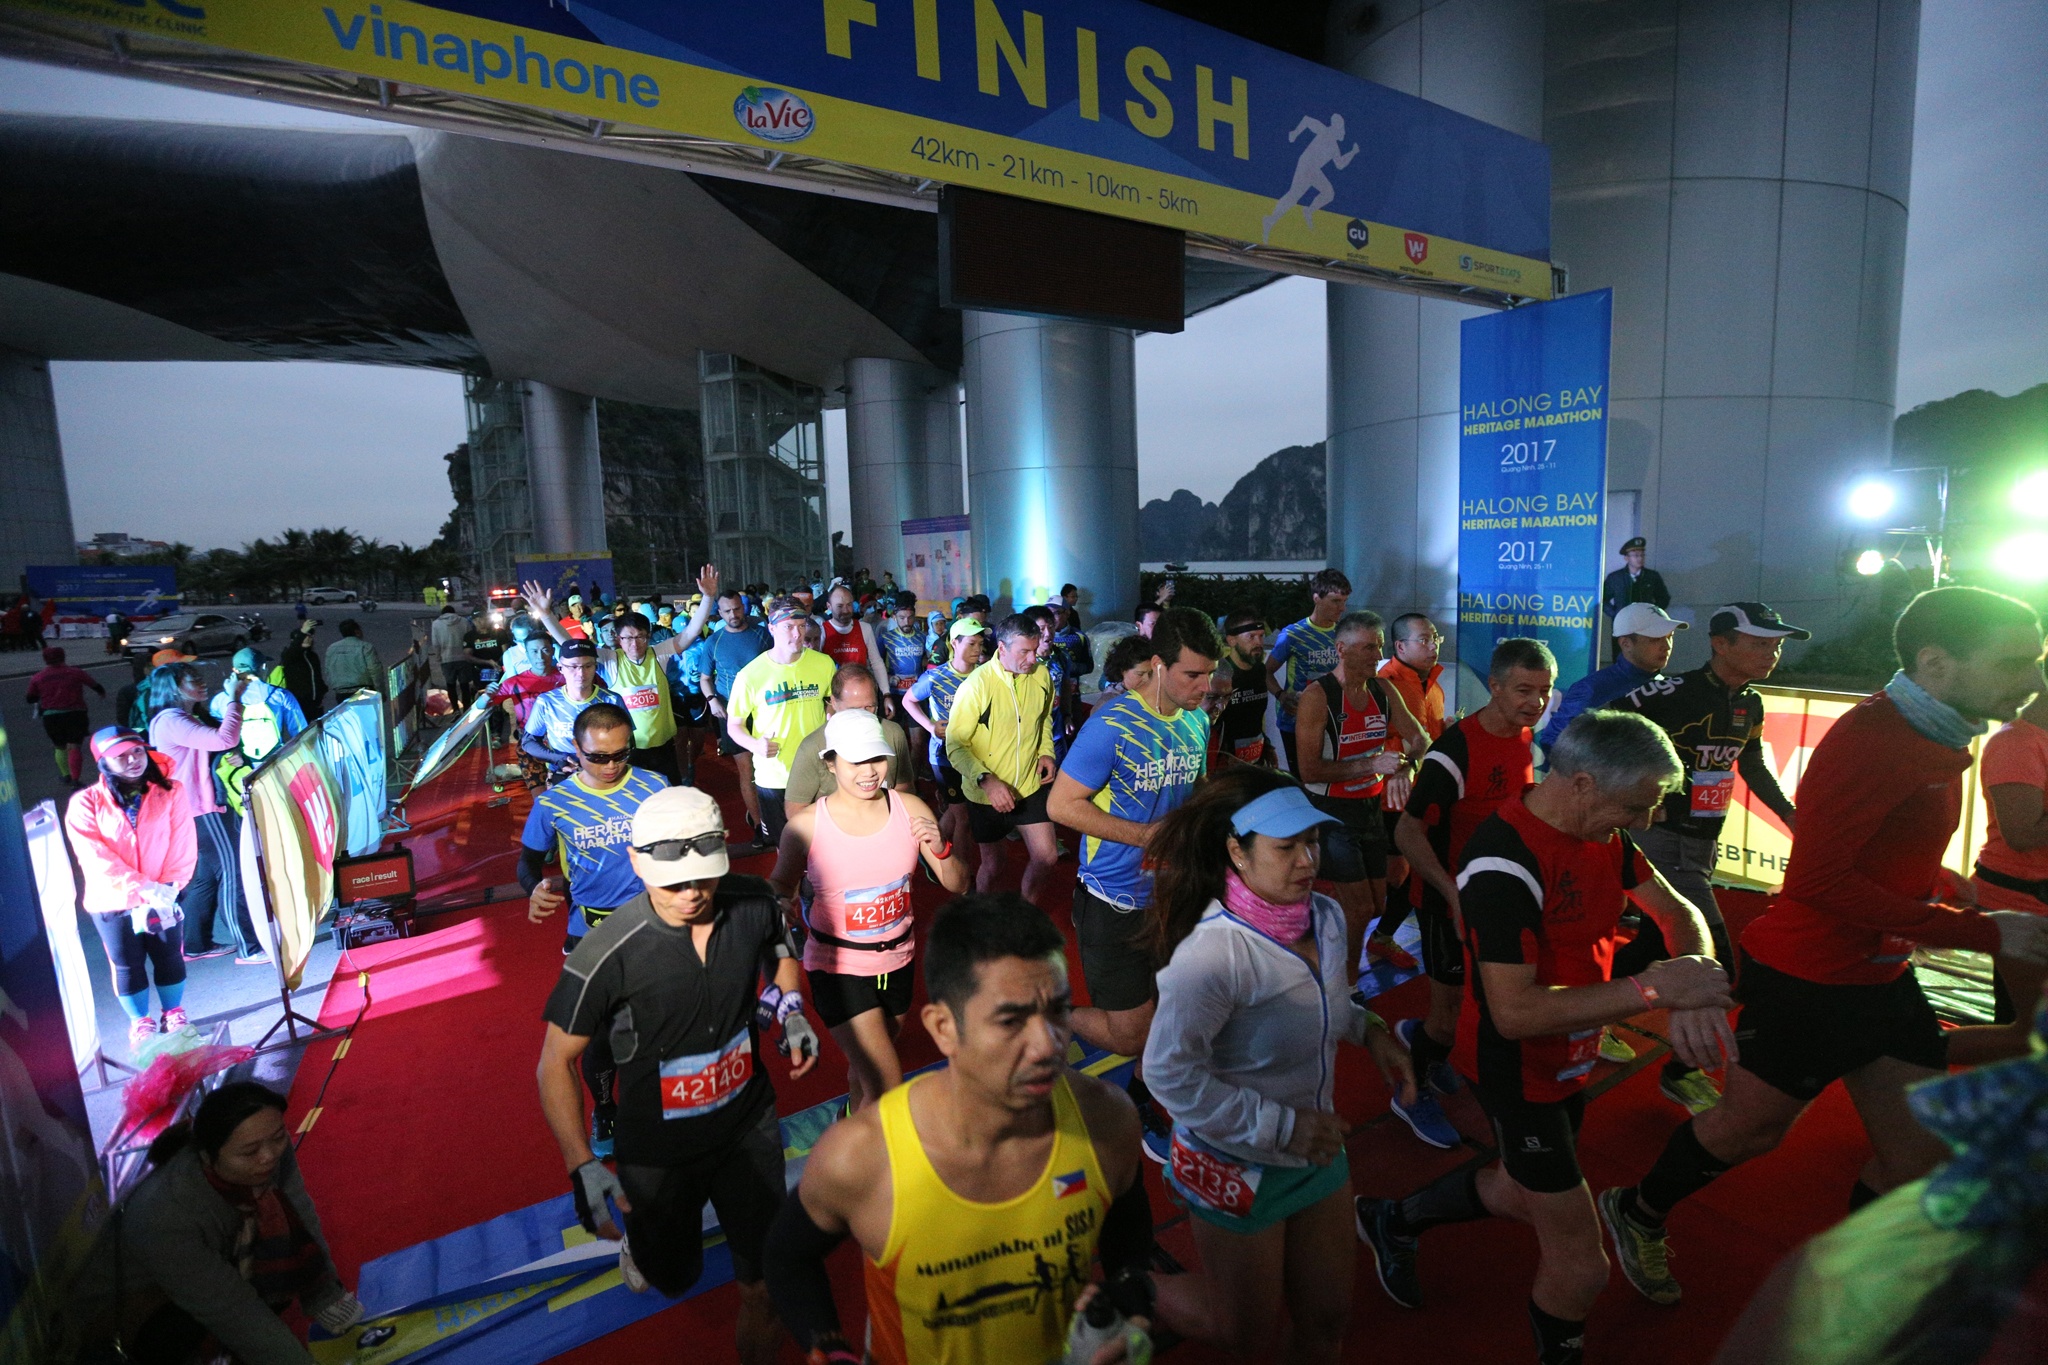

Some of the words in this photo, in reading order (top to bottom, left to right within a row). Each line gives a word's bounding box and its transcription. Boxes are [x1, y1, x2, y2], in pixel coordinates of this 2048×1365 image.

[324, 6, 660, 108] vinaphone
[823, 0, 1250, 161] FINISH
[911, 136, 979, 171] 42km
[1003, 154, 1064, 188] 21km
[1087, 172, 1140, 204] 10km
[1159, 188, 1198, 215] 5km
[1349, 228, 1366, 241] GU
[1464, 393, 1551, 421] HALONG
[1560, 385, 1602, 408] BAY
[1464, 419, 1521, 436] HERITAGE
[1524, 408, 1602, 429] MARATHON
[1501, 439, 1557, 465] 2017
[1463, 495, 1548, 515] HALONG
[1556, 492, 1598, 511] BAY
[1463, 518, 1518, 530] HERITAGE
[1522, 514, 1597, 528] MARATHON
[1498, 541, 1553, 562] 2017
[1460, 593, 1544, 611] HALONG
[1553, 595, 1594, 613] BAY
[1460, 612, 1514, 625] HERITAGE
[1518, 614, 1593, 629] MARATHON
[1349, 731, 1385, 741] INTERSPORT
[1135, 754, 1202, 779] HERITAGE
[852, 896, 905, 924] 42143
[671, 1058, 745, 1101] 42140
[1172, 1147, 1241, 1207] 42138
